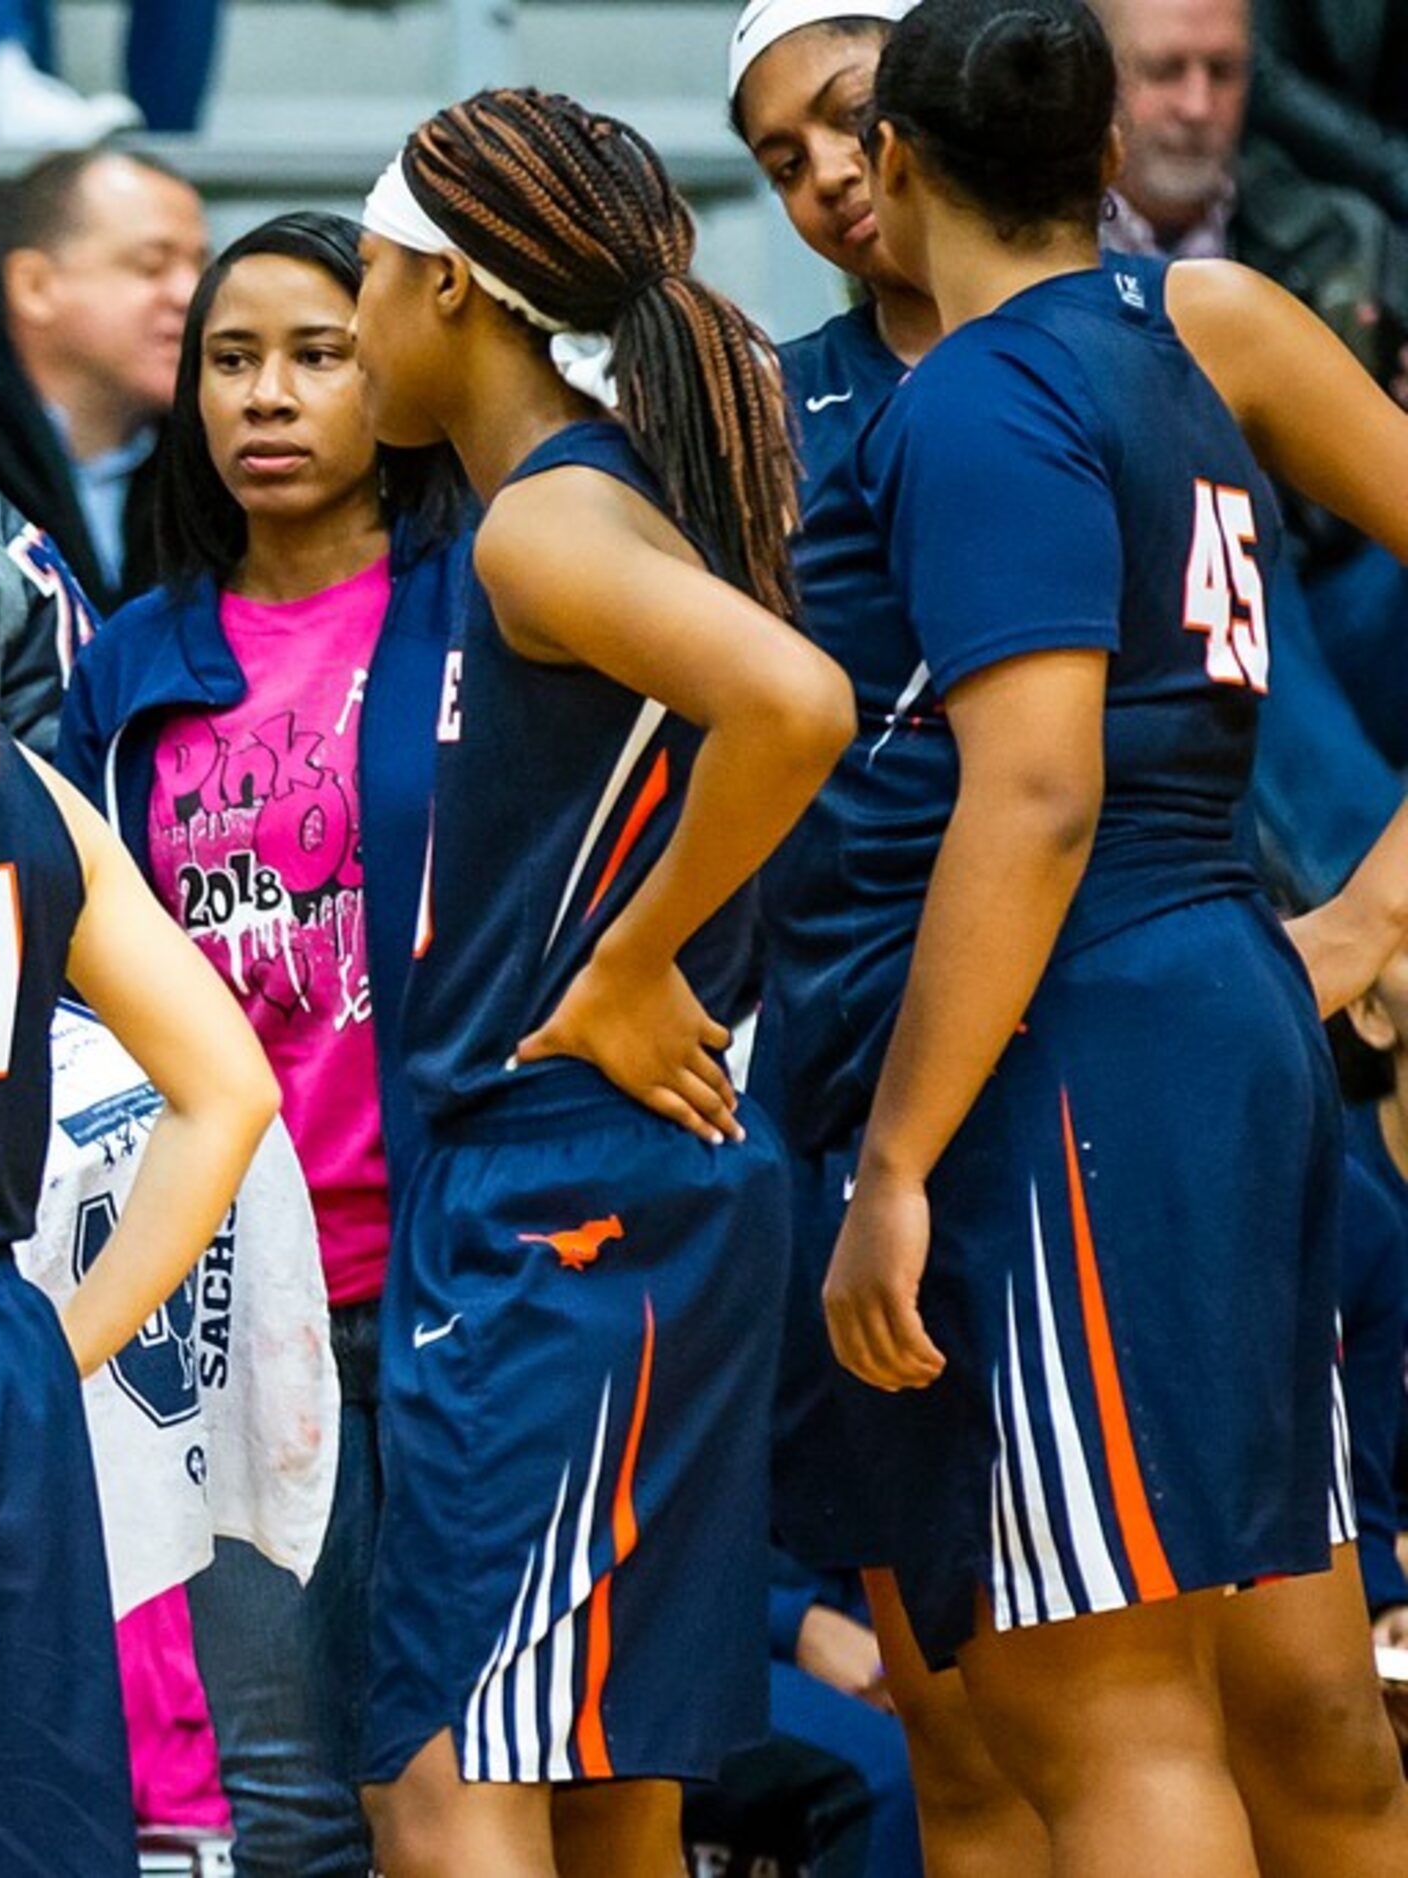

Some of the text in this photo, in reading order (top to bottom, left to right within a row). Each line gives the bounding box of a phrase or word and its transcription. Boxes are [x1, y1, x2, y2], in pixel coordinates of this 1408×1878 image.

[1183, 477, 1269, 695] 45
[155, 710, 326, 828] Pink
[177, 852, 283, 930] 2018
[198, 1201, 237, 1390] SACH
